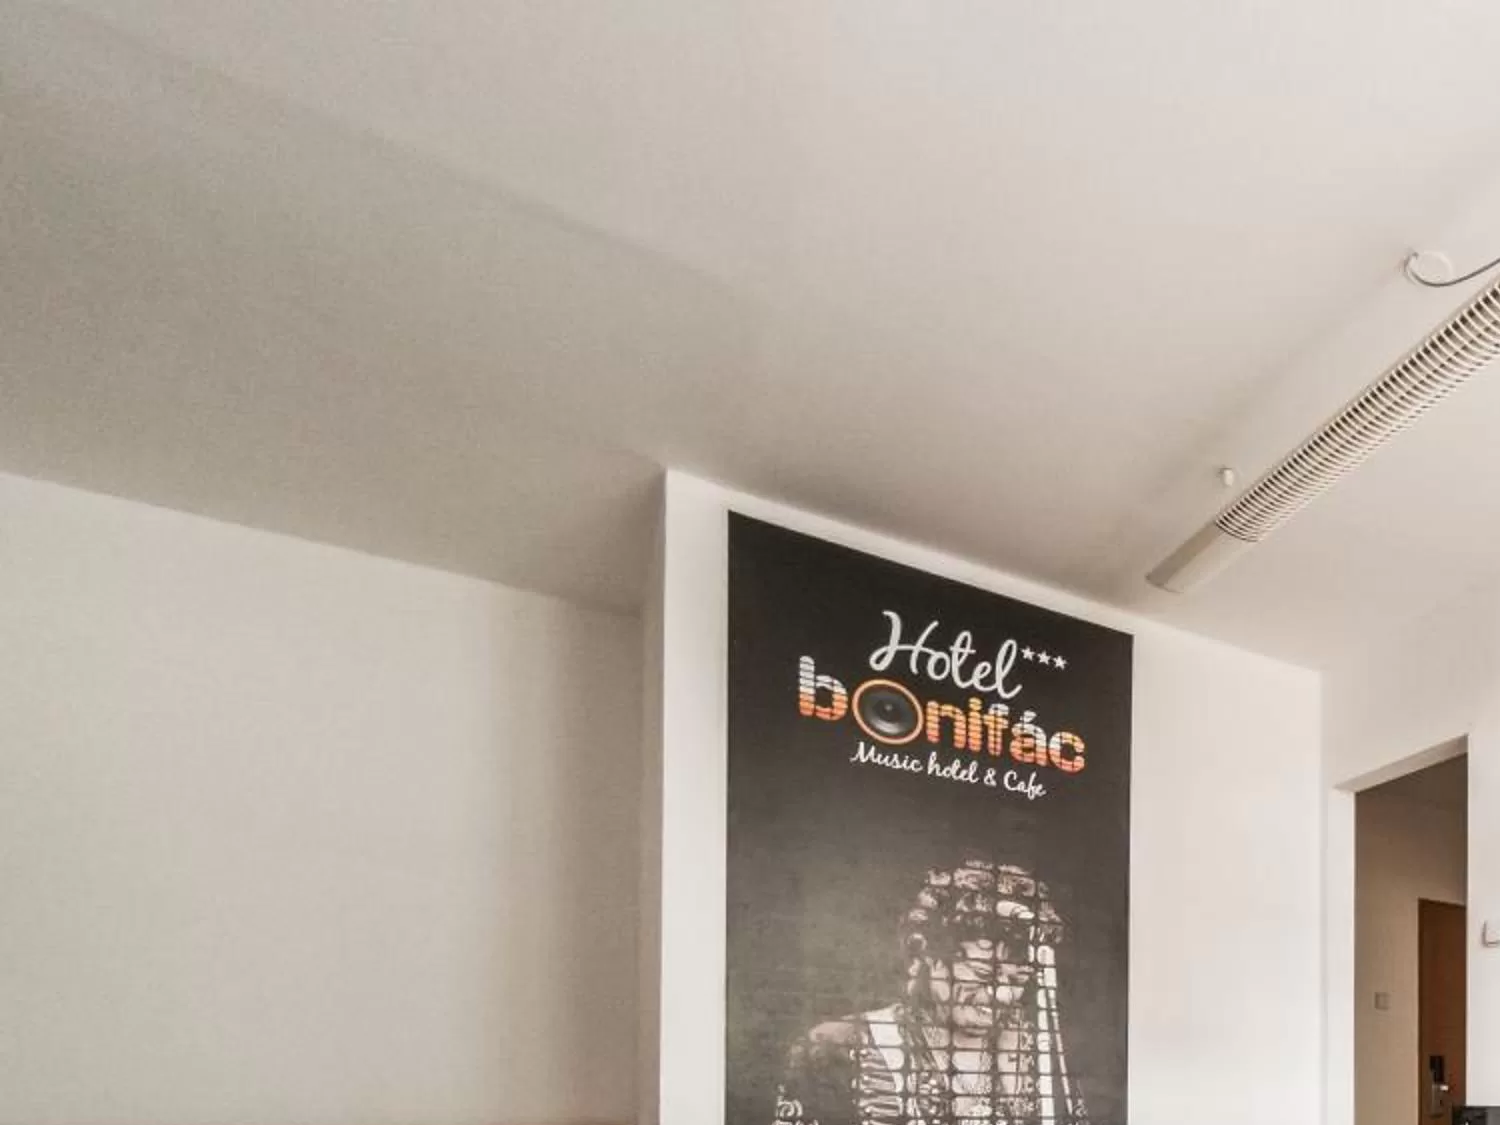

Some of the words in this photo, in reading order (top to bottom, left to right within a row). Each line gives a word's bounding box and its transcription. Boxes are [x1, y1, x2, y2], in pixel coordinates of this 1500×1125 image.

[869, 610, 1022, 699] Hotel
[798, 655, 1085, 774] bonifác
[850, 741, 923, 772] Music
[928, 752, 980, 784] hotel
[983, 768, 997, 788] &
